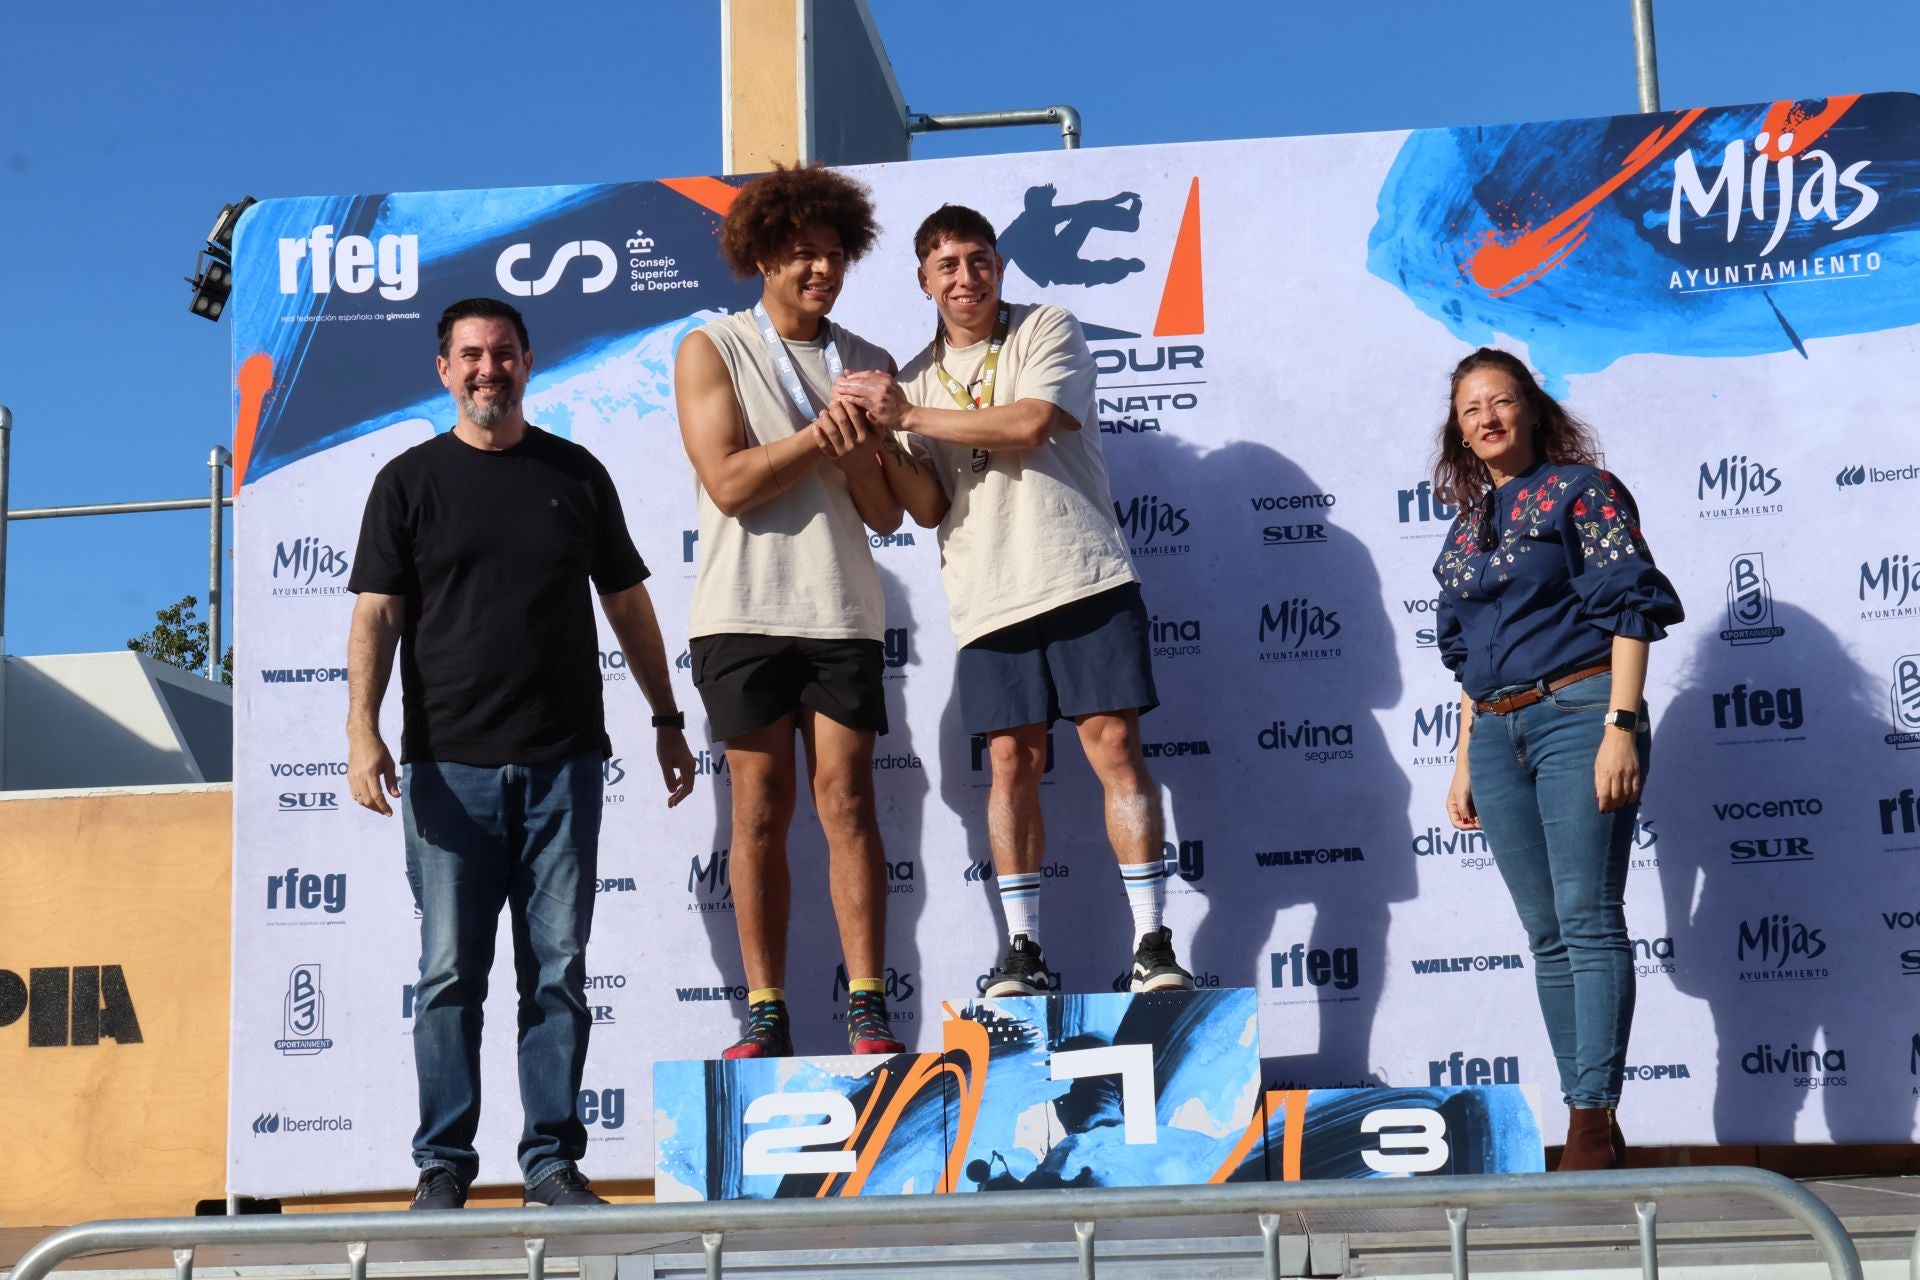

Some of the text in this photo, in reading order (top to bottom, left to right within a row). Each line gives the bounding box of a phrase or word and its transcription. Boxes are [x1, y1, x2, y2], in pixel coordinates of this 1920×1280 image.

[1668, 132, 1879, 257] Mijas
[279, 225, 419, 300] rfeg
[630, 256, 676, 269] Consejo
[1669, 252, 1881, 289] AYUNTAMIENTO
[631, 268, 679, 281] Superior
[631, 279, 699, 292] de Deportes
[338, 313, 373, 321] española
[386, 311, 420, 320] gimnasia
[1091, 345, 1205, 374] OUR
[1098, 393, 1198, 414] NATO
[1098, 415, 1162, 434] AÑA
[1698, 455, 1782, 506] Mijas
[1869, 464, 1920, 483] Iberdr
[1251, 493, 1336, 511] vocento
[1698, 504, 1783, 519] AYUNTAMIENTO
[1263, 524, 1327, 541] SUR
[1130, 544, 1190, 556] NTAMIENTO
[272, 536, 349, 586] Mijas
[272, 586, 348, 596] AYUNTAMIENTO
[1860, 606, 1920, 620] AYUNTAMI
[1150, 615, 1200, 643] ina
[1258, 598, 1341, 649] Mijas
[1722, 628, 1784, 640] SPORTAINMENT
[1152, 645, 1201, 659] seguros
[1259, 648, 1341, 661] AYUNTAMIENTO
[261, 668, 348, 683] WALLTOPI
[1712, 683, 1804, 730] rfeg
[1257, 719, 1353, 750] divina
[1412, 702, 1461, 754] Mij
[1142, 741, 1212, 758] LTOPIA
[1304, 749, 1354, 764] seguros
[872, 753, 922, 770] rdrola
[1413, 755, 1456, 766] AYUNTA
[270, 762, 349, 777] vocento
[278, 792, 339, 808] SUR
[1712, 798, 1823, 821] vocento
[1412, 827, 1489, 857] divin
[1729, 837, 1814, 860] SUR
[1162, 840, 1204, 881] eg
[1256, 847, 1365, 867] WALLTOPIA
[267, 867, 347, 914] rfeg
[687, 902, 735, 912] AYUNTAM
[1737, 913, 1827, 968] Mijas
[1270, 943, 1359, 990] rfeg
[1411, 954, 1525, 975] WALLTOPIA
[1634, 963, 1676, 978] eguros
[584, 975, 627, 990] ento
[1738, 968, 1829, 981] AYUNTAMIENTO
[675, 986, 749, 1002] WALLTO
[277, 1039, 331, 1050] SPORTAINMENT
[1741, 1043, 1846, 1075] divina
[1623, 1064, 1691, 1081] TOPIA
[1793, 1074, 1848, 1090] seguros
[576, 1088, 625, 1130] eg
[283, 1115, 353, 1132] Iberdrola
[742, 1091, 858, 1176] 2
[1360, 1108, 1450, 1173] 3
